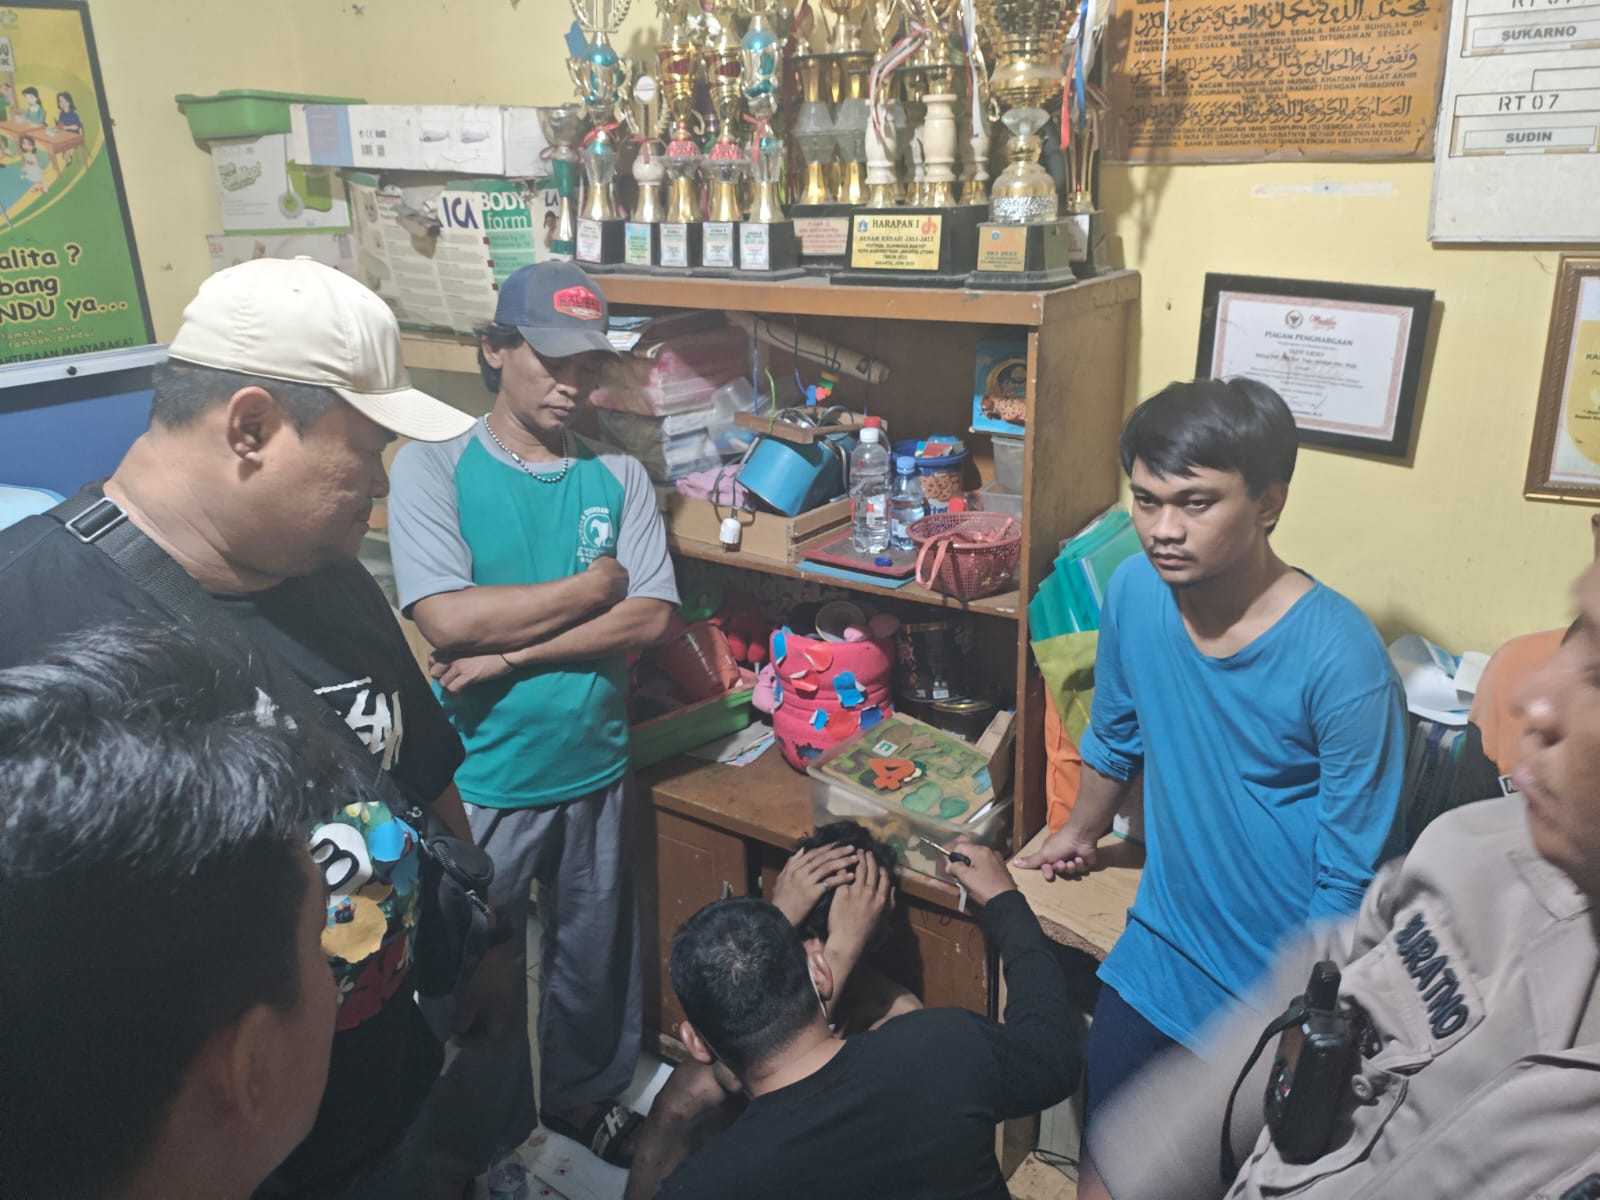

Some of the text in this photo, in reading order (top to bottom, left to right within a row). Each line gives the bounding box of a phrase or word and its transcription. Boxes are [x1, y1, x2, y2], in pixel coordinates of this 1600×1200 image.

[1502, 26, 1577, 41] SUKARNO
[1498, 94, 1560, 112] RT 07
[1505, 131, 1553, 144] SUDIN
[487, 210, 528, 230] form
[872, 218, 913, 229] HARAPAN
[66, 244, 81, 263] ?
